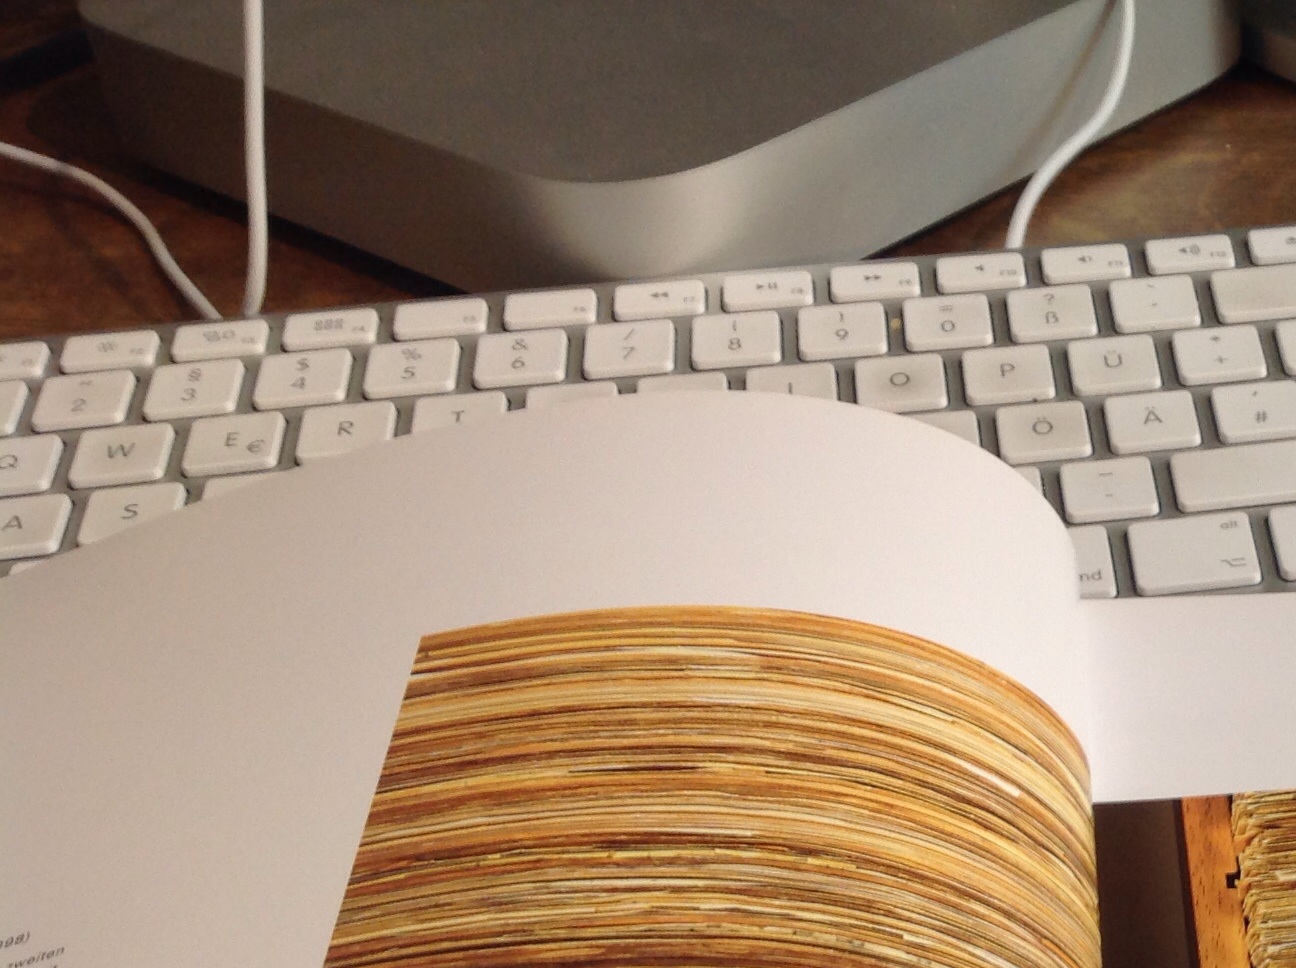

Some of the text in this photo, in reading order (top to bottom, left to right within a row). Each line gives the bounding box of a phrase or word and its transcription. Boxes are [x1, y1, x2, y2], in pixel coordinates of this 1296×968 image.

[835, 328, 849, 340] 9
[728, 338, 742, 351] 8
[622, 346, 636, 360] 7
[1103, 350, 1123, 368] Ü
[512, 356, 526, 370] 6
[999, 363, 1015, 379] P
[400, 366, 416, 380] 5
[889, 371, 910, 387] O
[70, 398, 87, 413] 2
[451, 409, 467, 424] T
[1143, 406, 1163, 425] Ä
[336, 420, 355, 436] R
[1031, 416, 1054, 435] Ö
[106, 442, 136, 459] W
[0, 454, 18, 470] Q
[121, 504, 139, 520] S
[1, 515, 23, 531] A
[1220, 519, 1238, 531] alt
